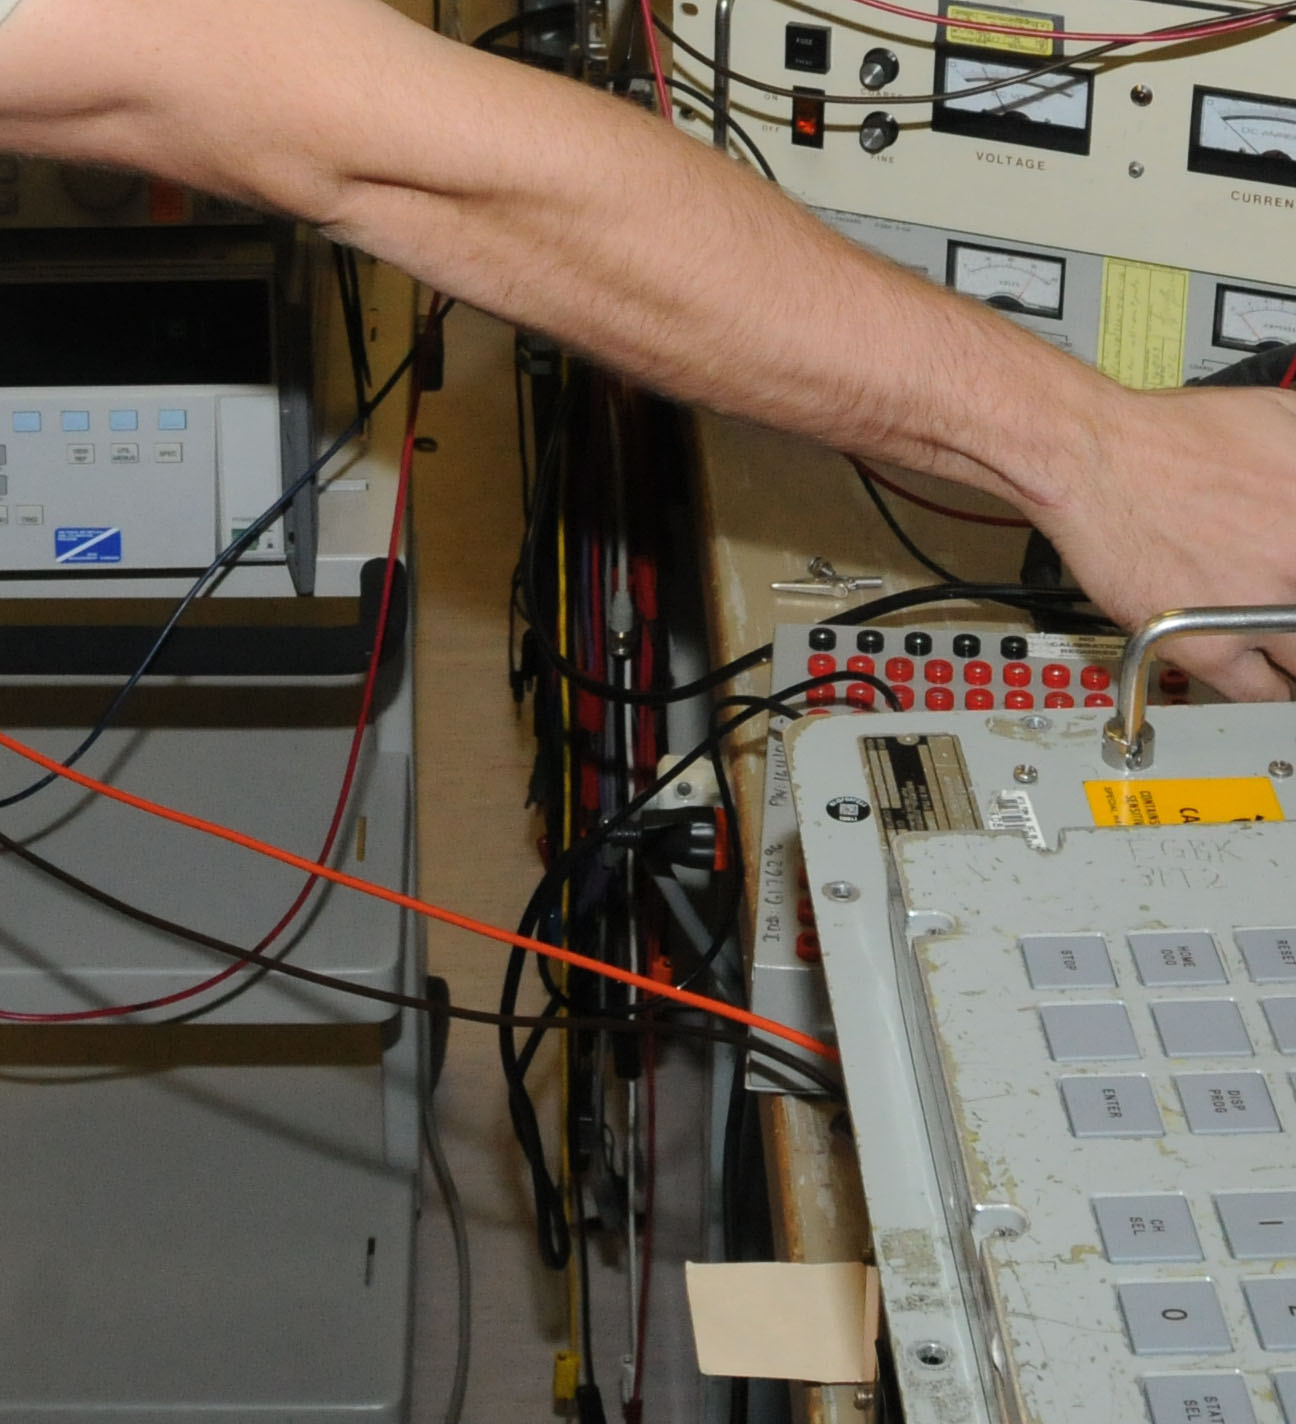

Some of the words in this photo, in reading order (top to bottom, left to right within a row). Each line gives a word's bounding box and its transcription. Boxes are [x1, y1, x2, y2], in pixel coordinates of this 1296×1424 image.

[763, 93, 779, 103] ON
[976, 150, 1048, 172] VOLTAGE
[1060, 949, 1078, 972] STOP
[1176, 944, 1197, 969] HOME
[1102, 1087, 1123, 1120] ENTER
[1208, 1087, 1228, 1114] PROG
[1227, 1089, 1247, 1113] DISP
[1129, 1215, 1147, 1237] SEL
[1150, 1218, 1166, 1234] CH
[1258, 1218, 1285, 1227] 1
[1160, 1307, 1190, 1323] 0
[1183, 1398, 1204, 1423] SEL
[1203, 1395, 1226, 1424] STAT
